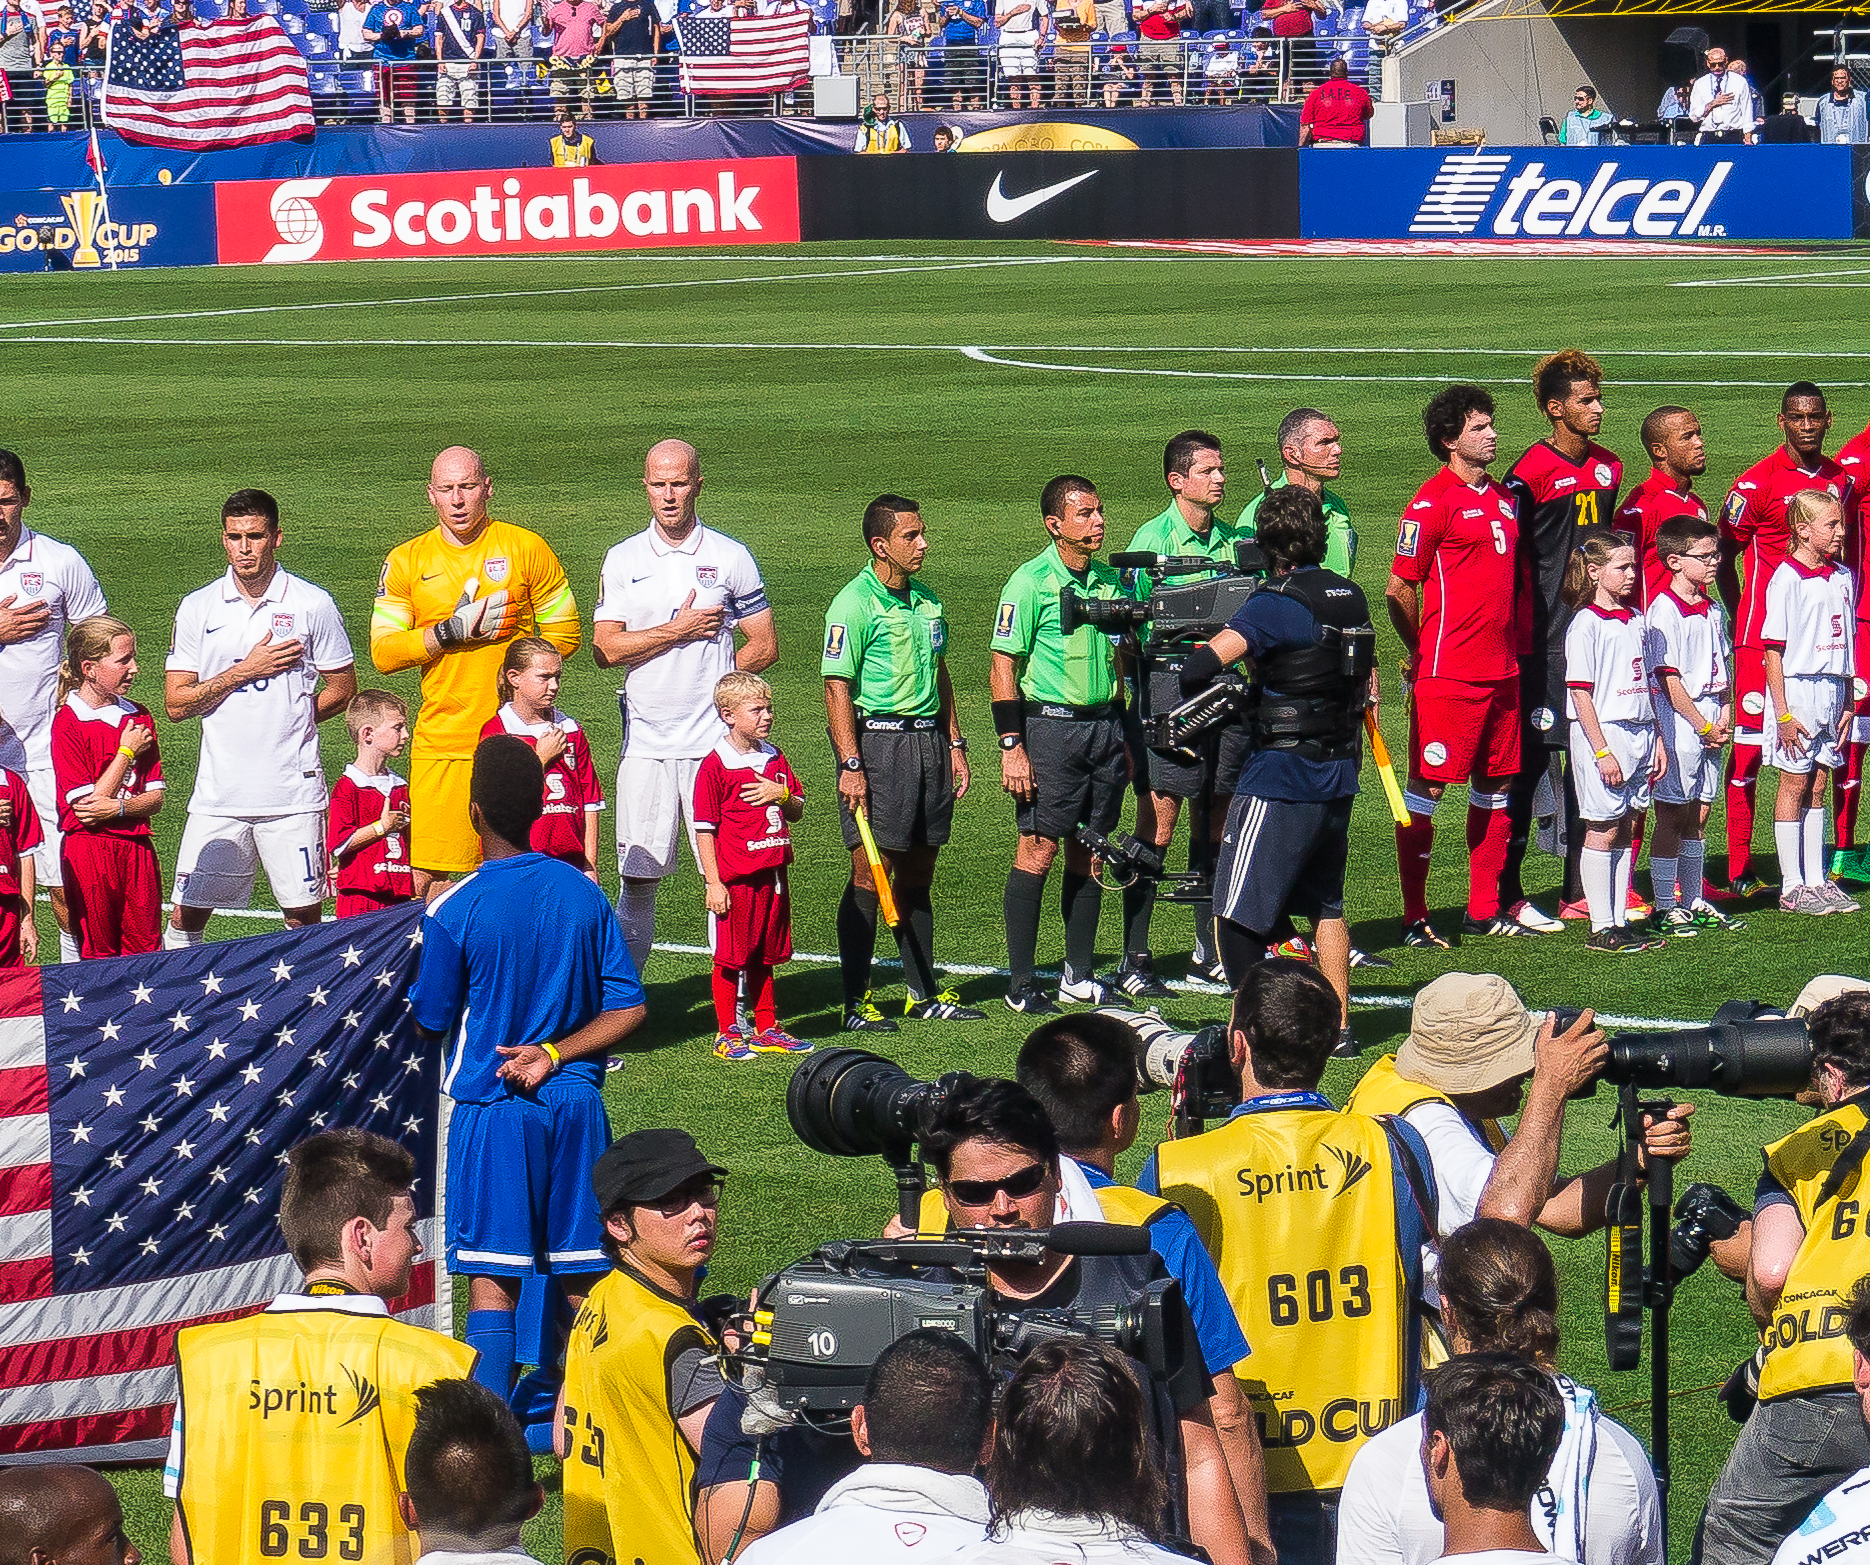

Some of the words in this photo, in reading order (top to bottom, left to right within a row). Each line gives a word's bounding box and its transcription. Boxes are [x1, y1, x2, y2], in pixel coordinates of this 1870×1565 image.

[352, 171, 762, 248] Scotiabank
[1492, 161, 1733, 236] telcel
[95, 222, 158, 247] CUP
[1697, 224, 1726, 237] M.R.
[102, 248, 139, 263] 2015
[1575, 491, 1598, 526] 21
[1490, 520, 1506, 555] 5
[1237, 1163, 1329, 1204] Sprint
[1267, 1264, 1372, 1327] 603
[1783, 1289, 1838, 1304] CONCACAF
[808, 1332, 836, 1356] 10
[249, 1379, 337, 1419] Sprint
[260, 1500, 365, 1561] 633
